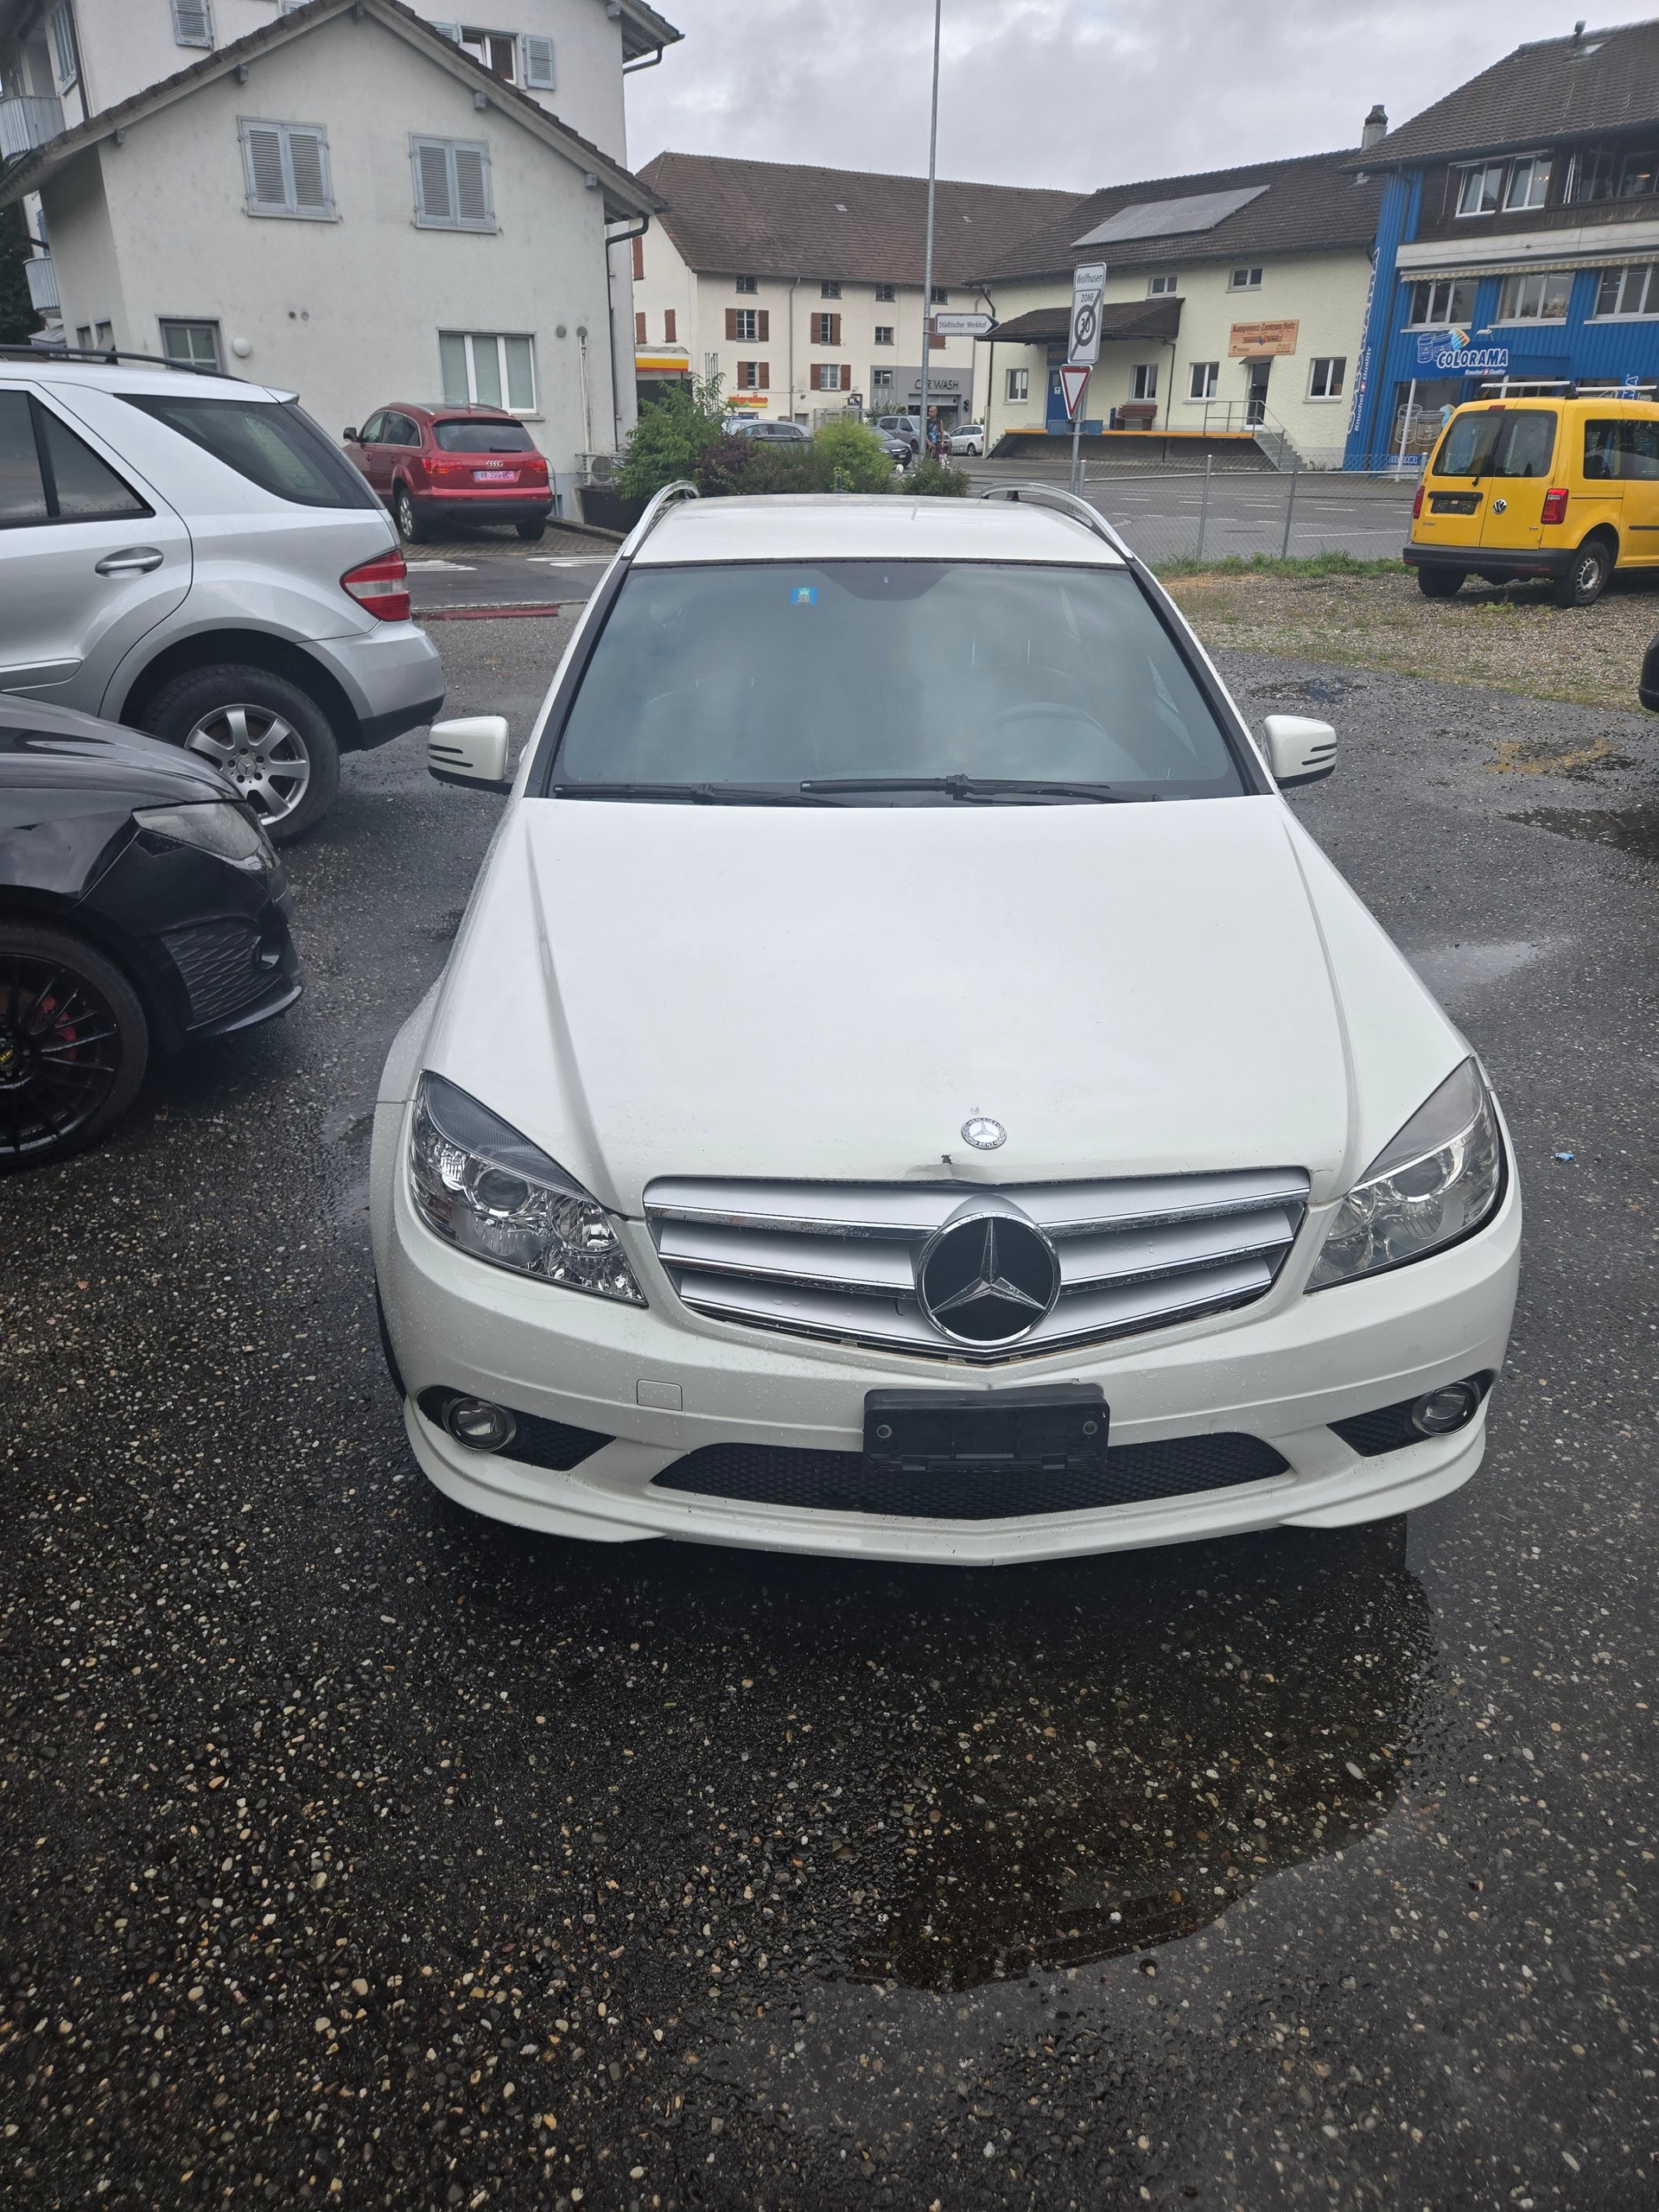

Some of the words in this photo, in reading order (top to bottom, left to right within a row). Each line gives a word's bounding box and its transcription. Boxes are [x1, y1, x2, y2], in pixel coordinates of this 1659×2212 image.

[1081, 294, 1094, 302] ZONE
[1080, 318, 1091, 334] 30
[1233, 323, 1282, 334] Kompetenz-Zentrum
[1363, 346, 1372, 380] Quality
[1437, 348, 1509, 369] COLORAMA
[915, 379, 931, 390] CR
[933, 379, 959, 390] WASH
[1389, 455, 1419, 464] COLRAMA
